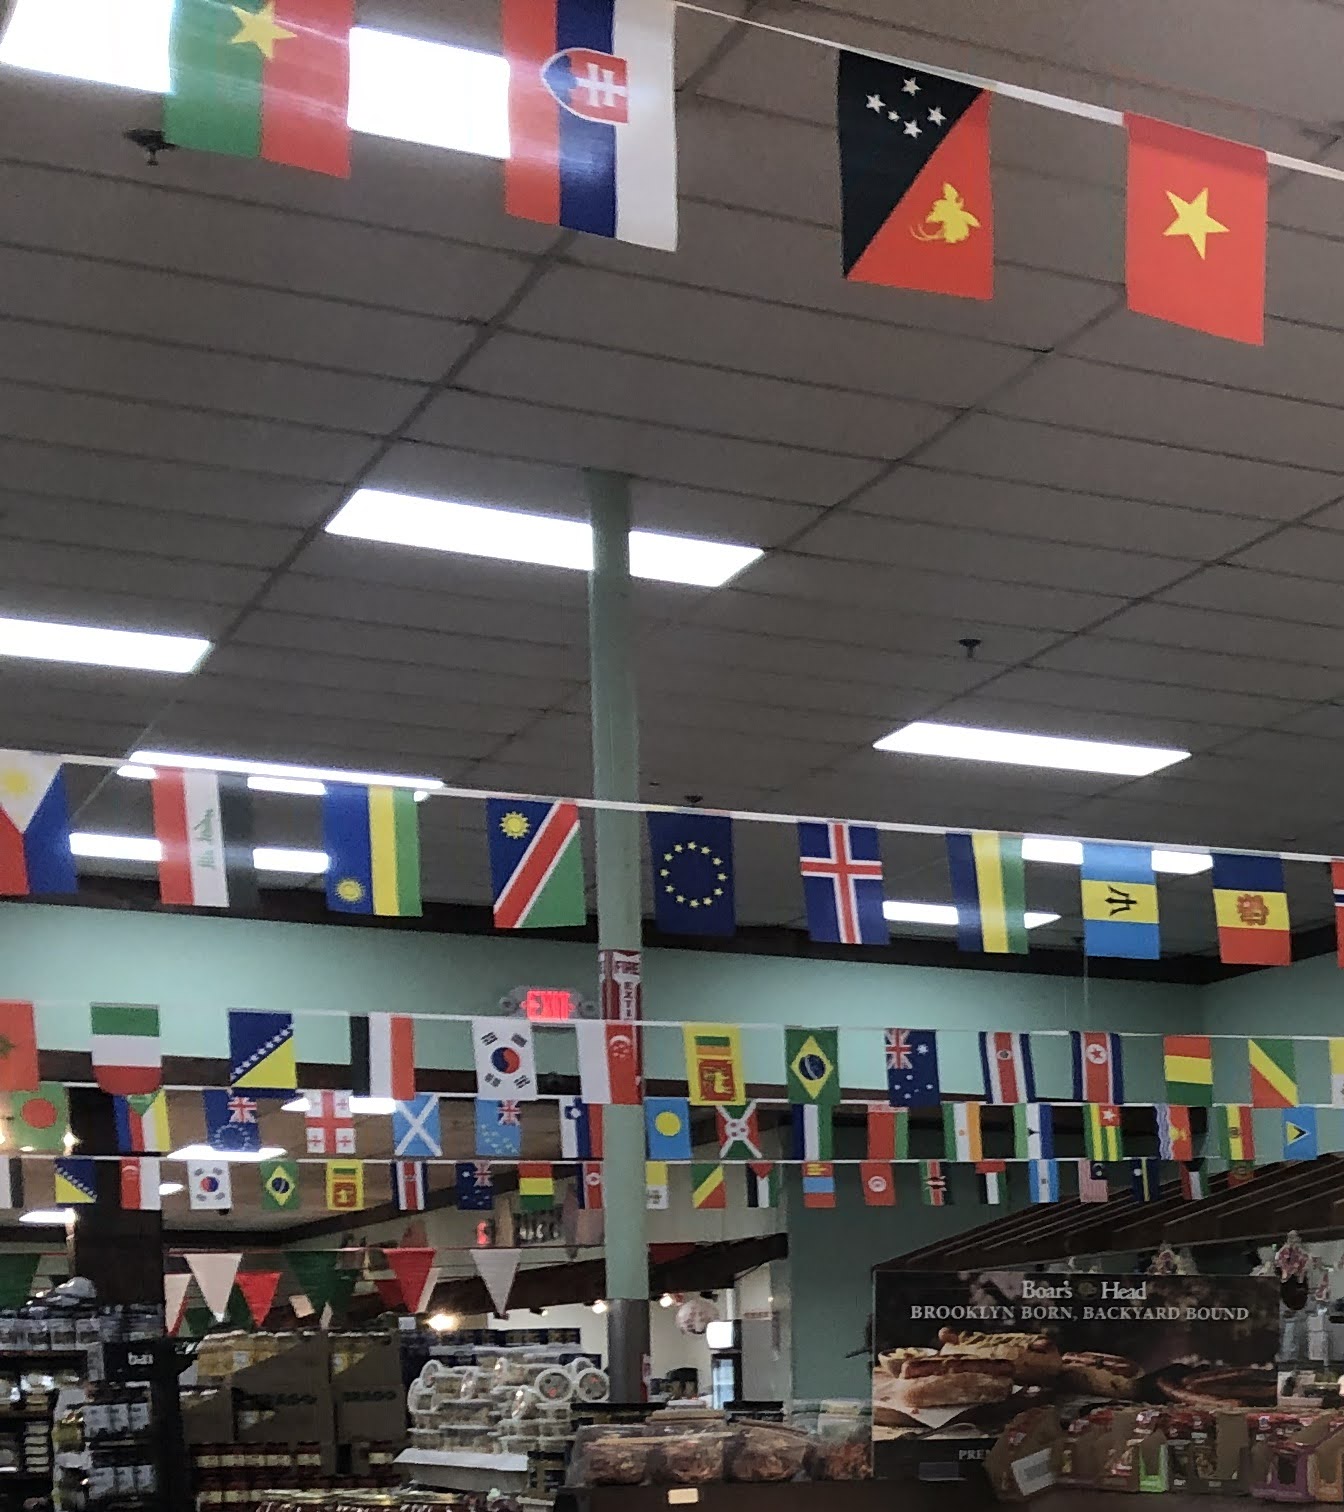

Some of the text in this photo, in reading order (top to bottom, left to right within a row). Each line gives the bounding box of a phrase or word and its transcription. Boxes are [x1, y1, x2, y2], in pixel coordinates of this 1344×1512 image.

[1021, 1280, 1147, 1300] Boar's Head
[910, 1305, 1250, 1321] BROOKLYN BORN, BACKYARD BOUND
